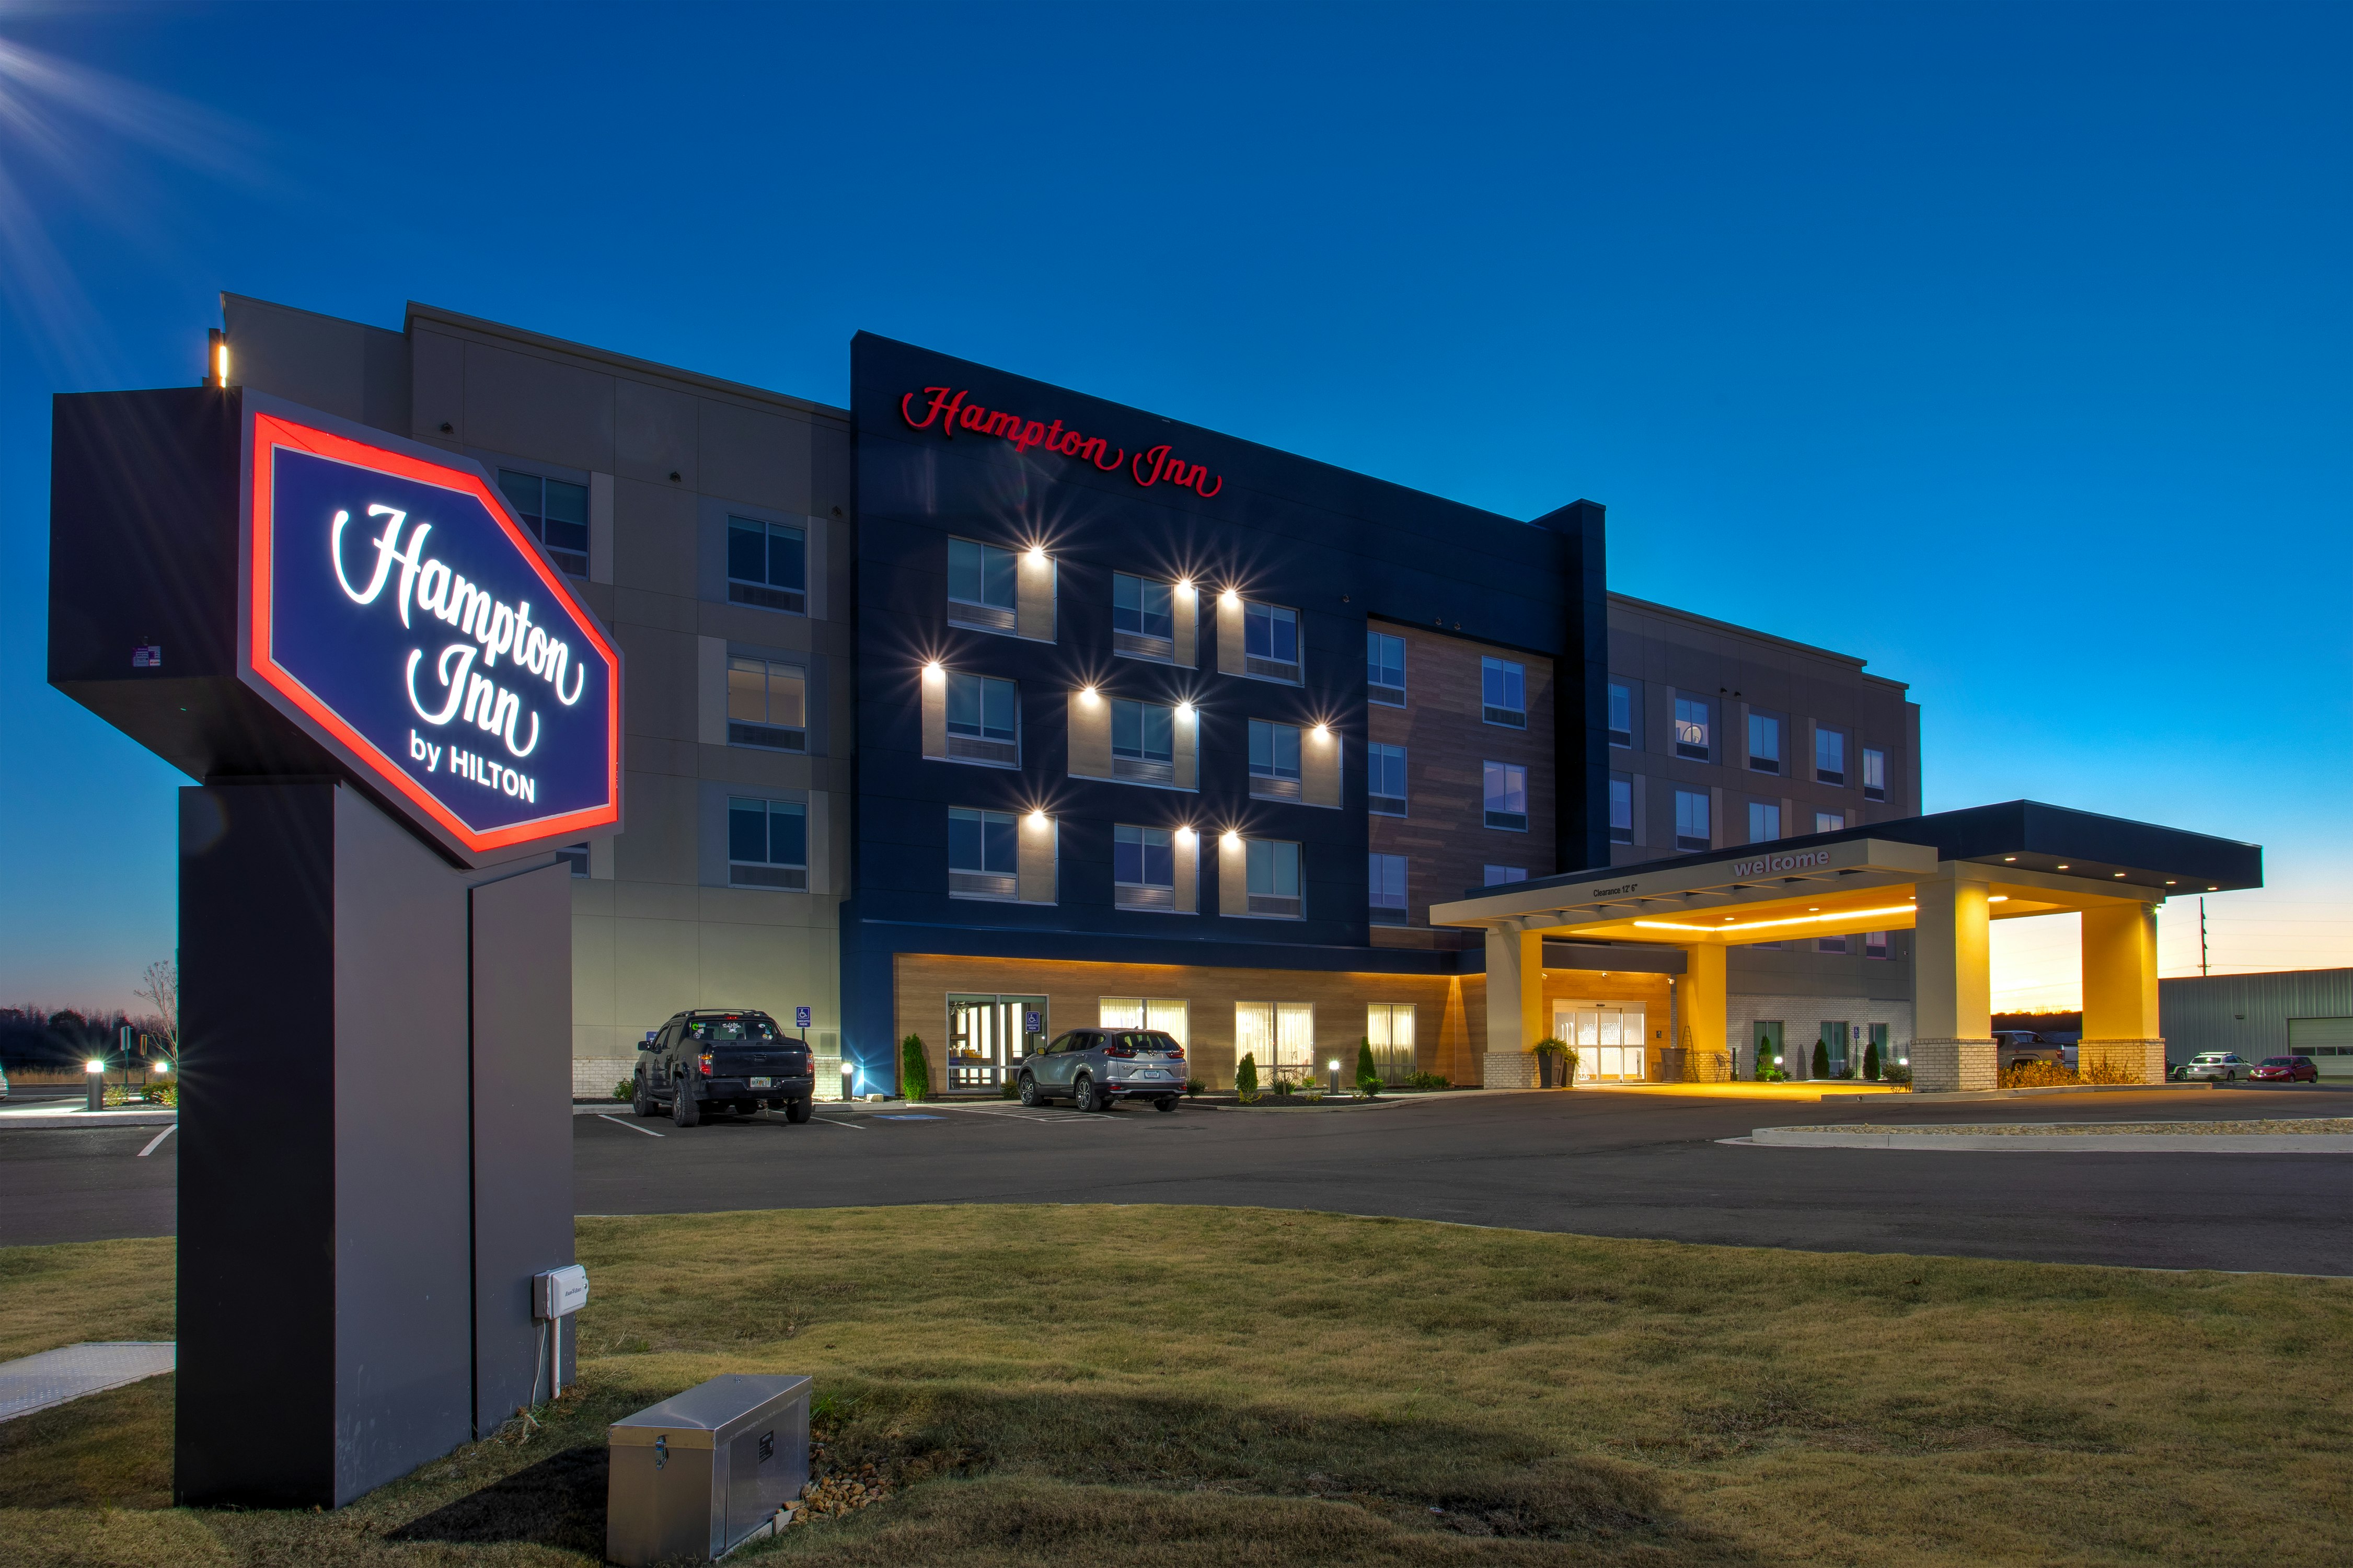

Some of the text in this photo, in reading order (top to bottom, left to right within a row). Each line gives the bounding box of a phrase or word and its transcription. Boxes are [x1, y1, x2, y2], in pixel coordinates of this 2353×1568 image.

[902, 387, 1222, 497] Hampton Inn
[332, 503, 584, 706] Hampton
[407, 644, 539, 757] Inn
[411, 729, 535, 803] by HILTON
[1594, 888, 1621, 897] Clearance
[1622, 884, 1630, 893] 12'
[1734, 850, 1829, 877] welcome
